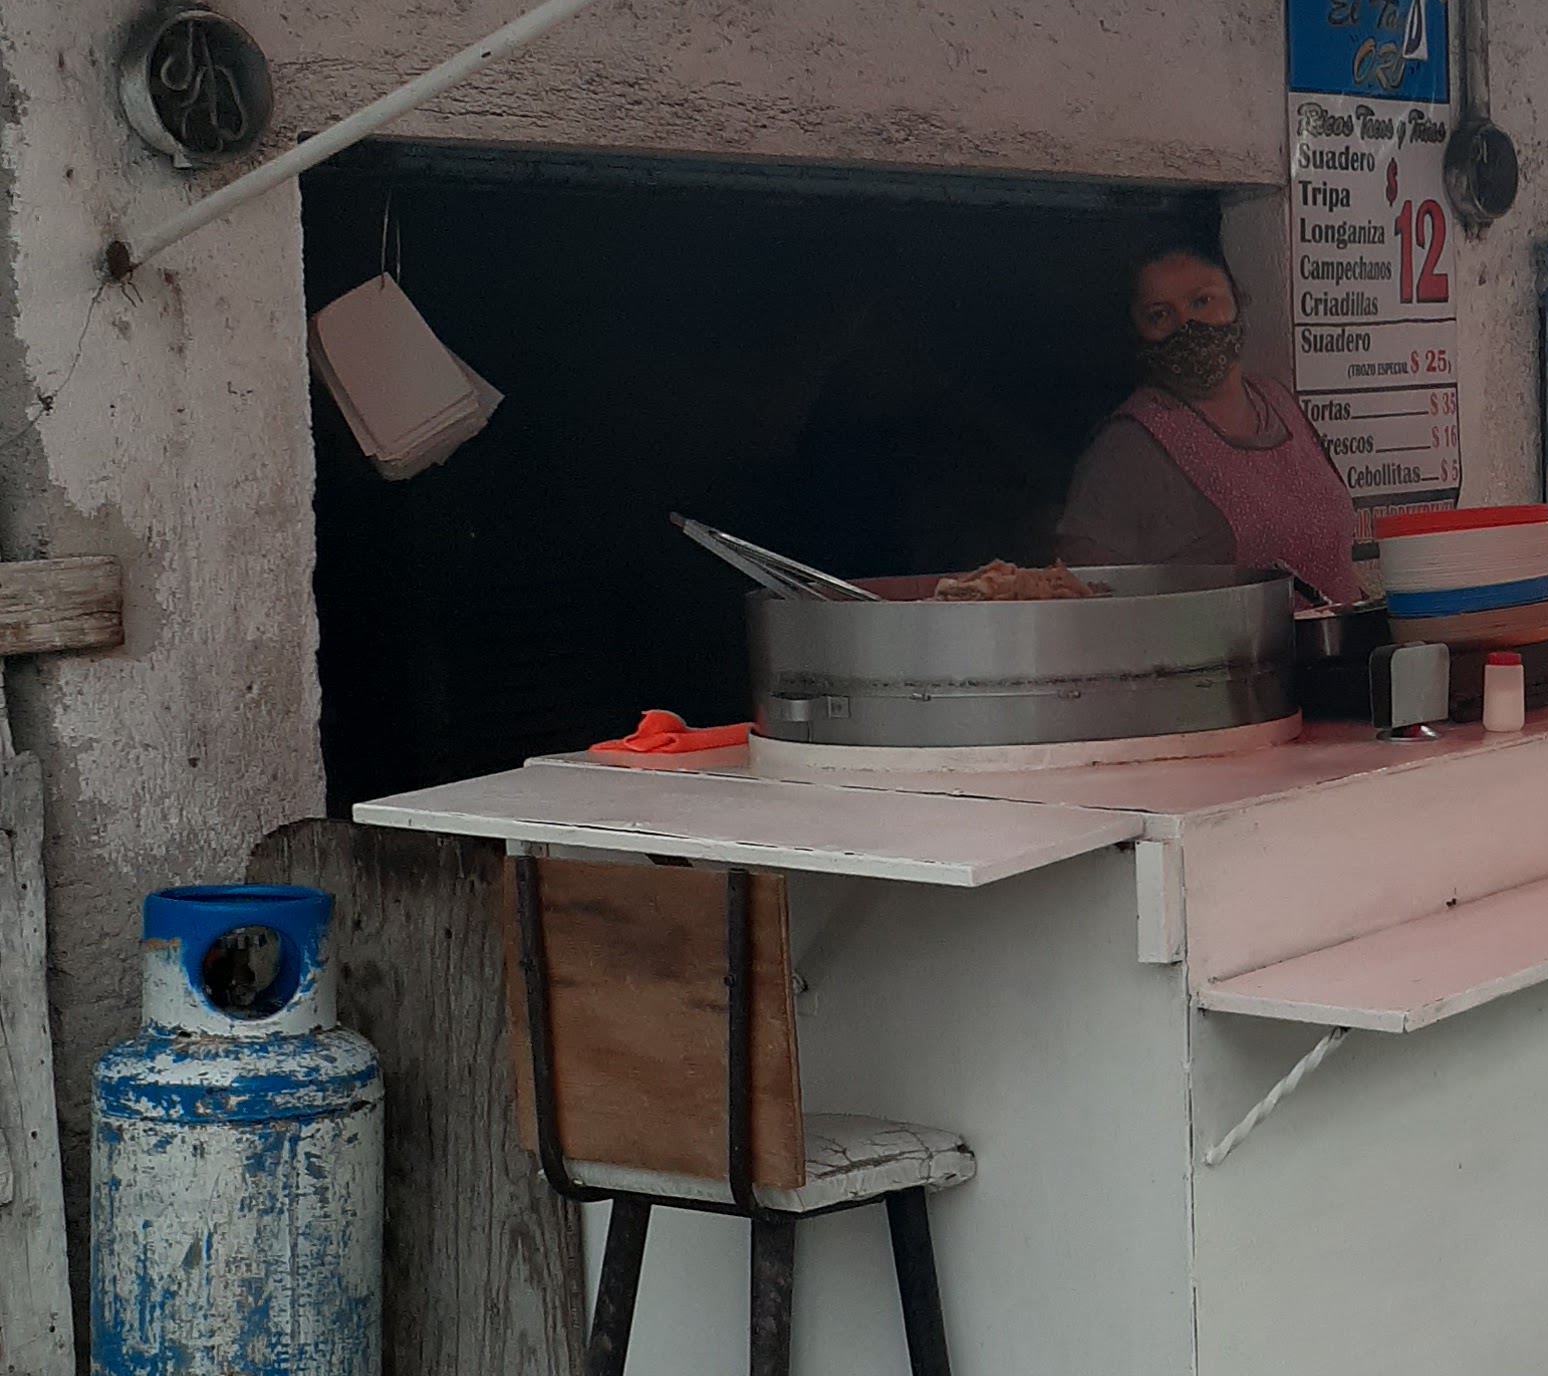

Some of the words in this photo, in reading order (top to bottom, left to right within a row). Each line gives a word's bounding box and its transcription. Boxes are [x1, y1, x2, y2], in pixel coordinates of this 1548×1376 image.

[1355, 104, 1393, 142] Tacos
[1299, 143, 1375, 172] Suadero
[1299, 180, 1351, 213] Tripa
[1300, 217, 1385, 250] Longaniza
[1394, 199, 1449, 304] 12
[1300, 254, 1392, 286] Campechanos
[1301, 291, 1379, 317] Criadillas
[1301, 328, 1371, 354] Suadero
[1301, 398, 1351, 422] Tortas
[1443, 391, 1457, 415] 35
[1319, 433, 1374, 457] frescos
[1347, 462, 1421, 489] Cebollitas
